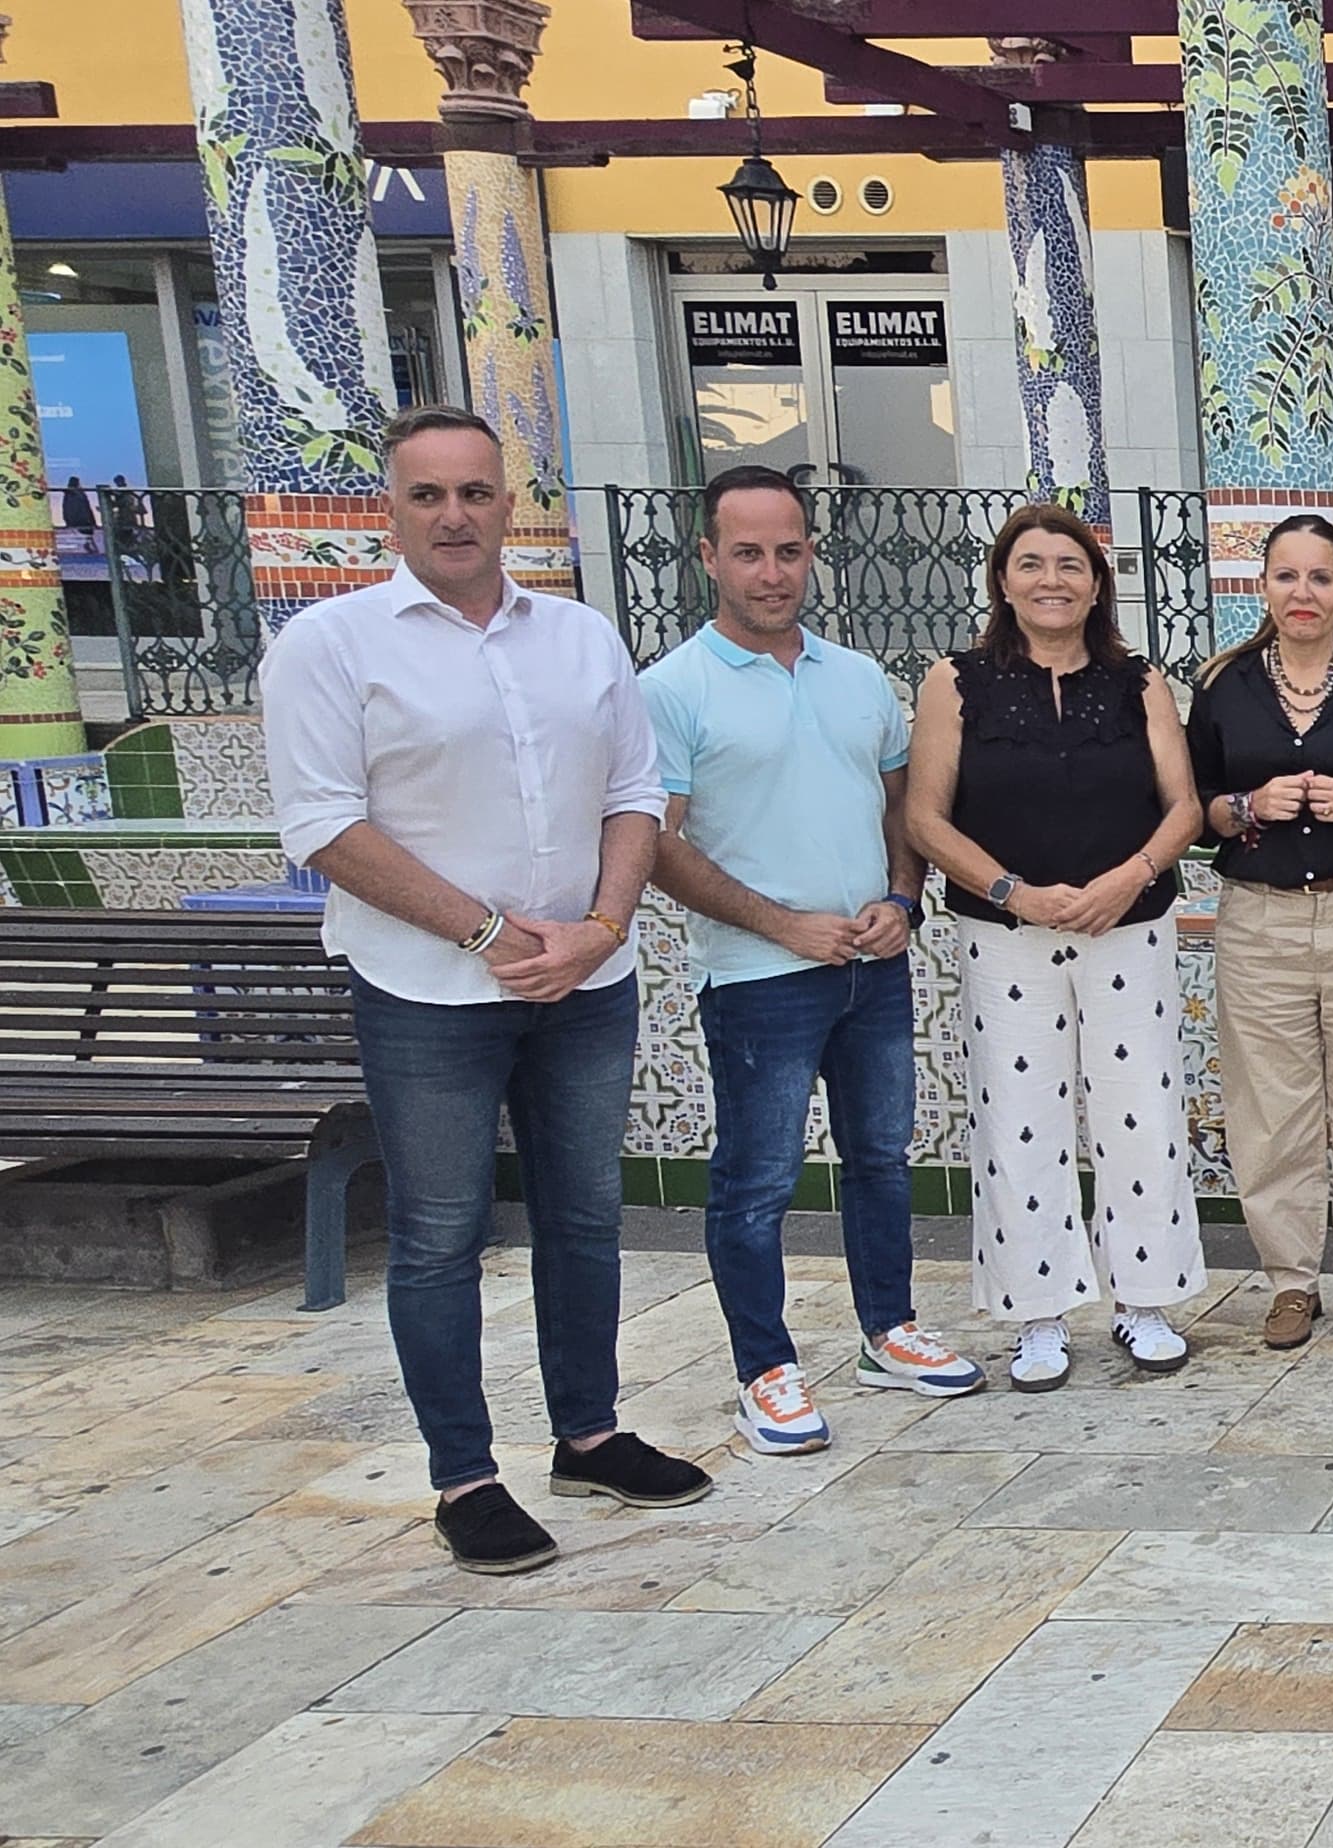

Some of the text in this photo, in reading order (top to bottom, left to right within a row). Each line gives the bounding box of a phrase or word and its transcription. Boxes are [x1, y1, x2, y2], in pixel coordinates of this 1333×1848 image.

[692, 311, 792, 335] ELIMAT
[835, 310, 939, 335] ELIMAT
[692, 337, 768, 347] EQUIPAMIENTOS
[835, 337, 913, 347] EQUIPAMIENTOS
